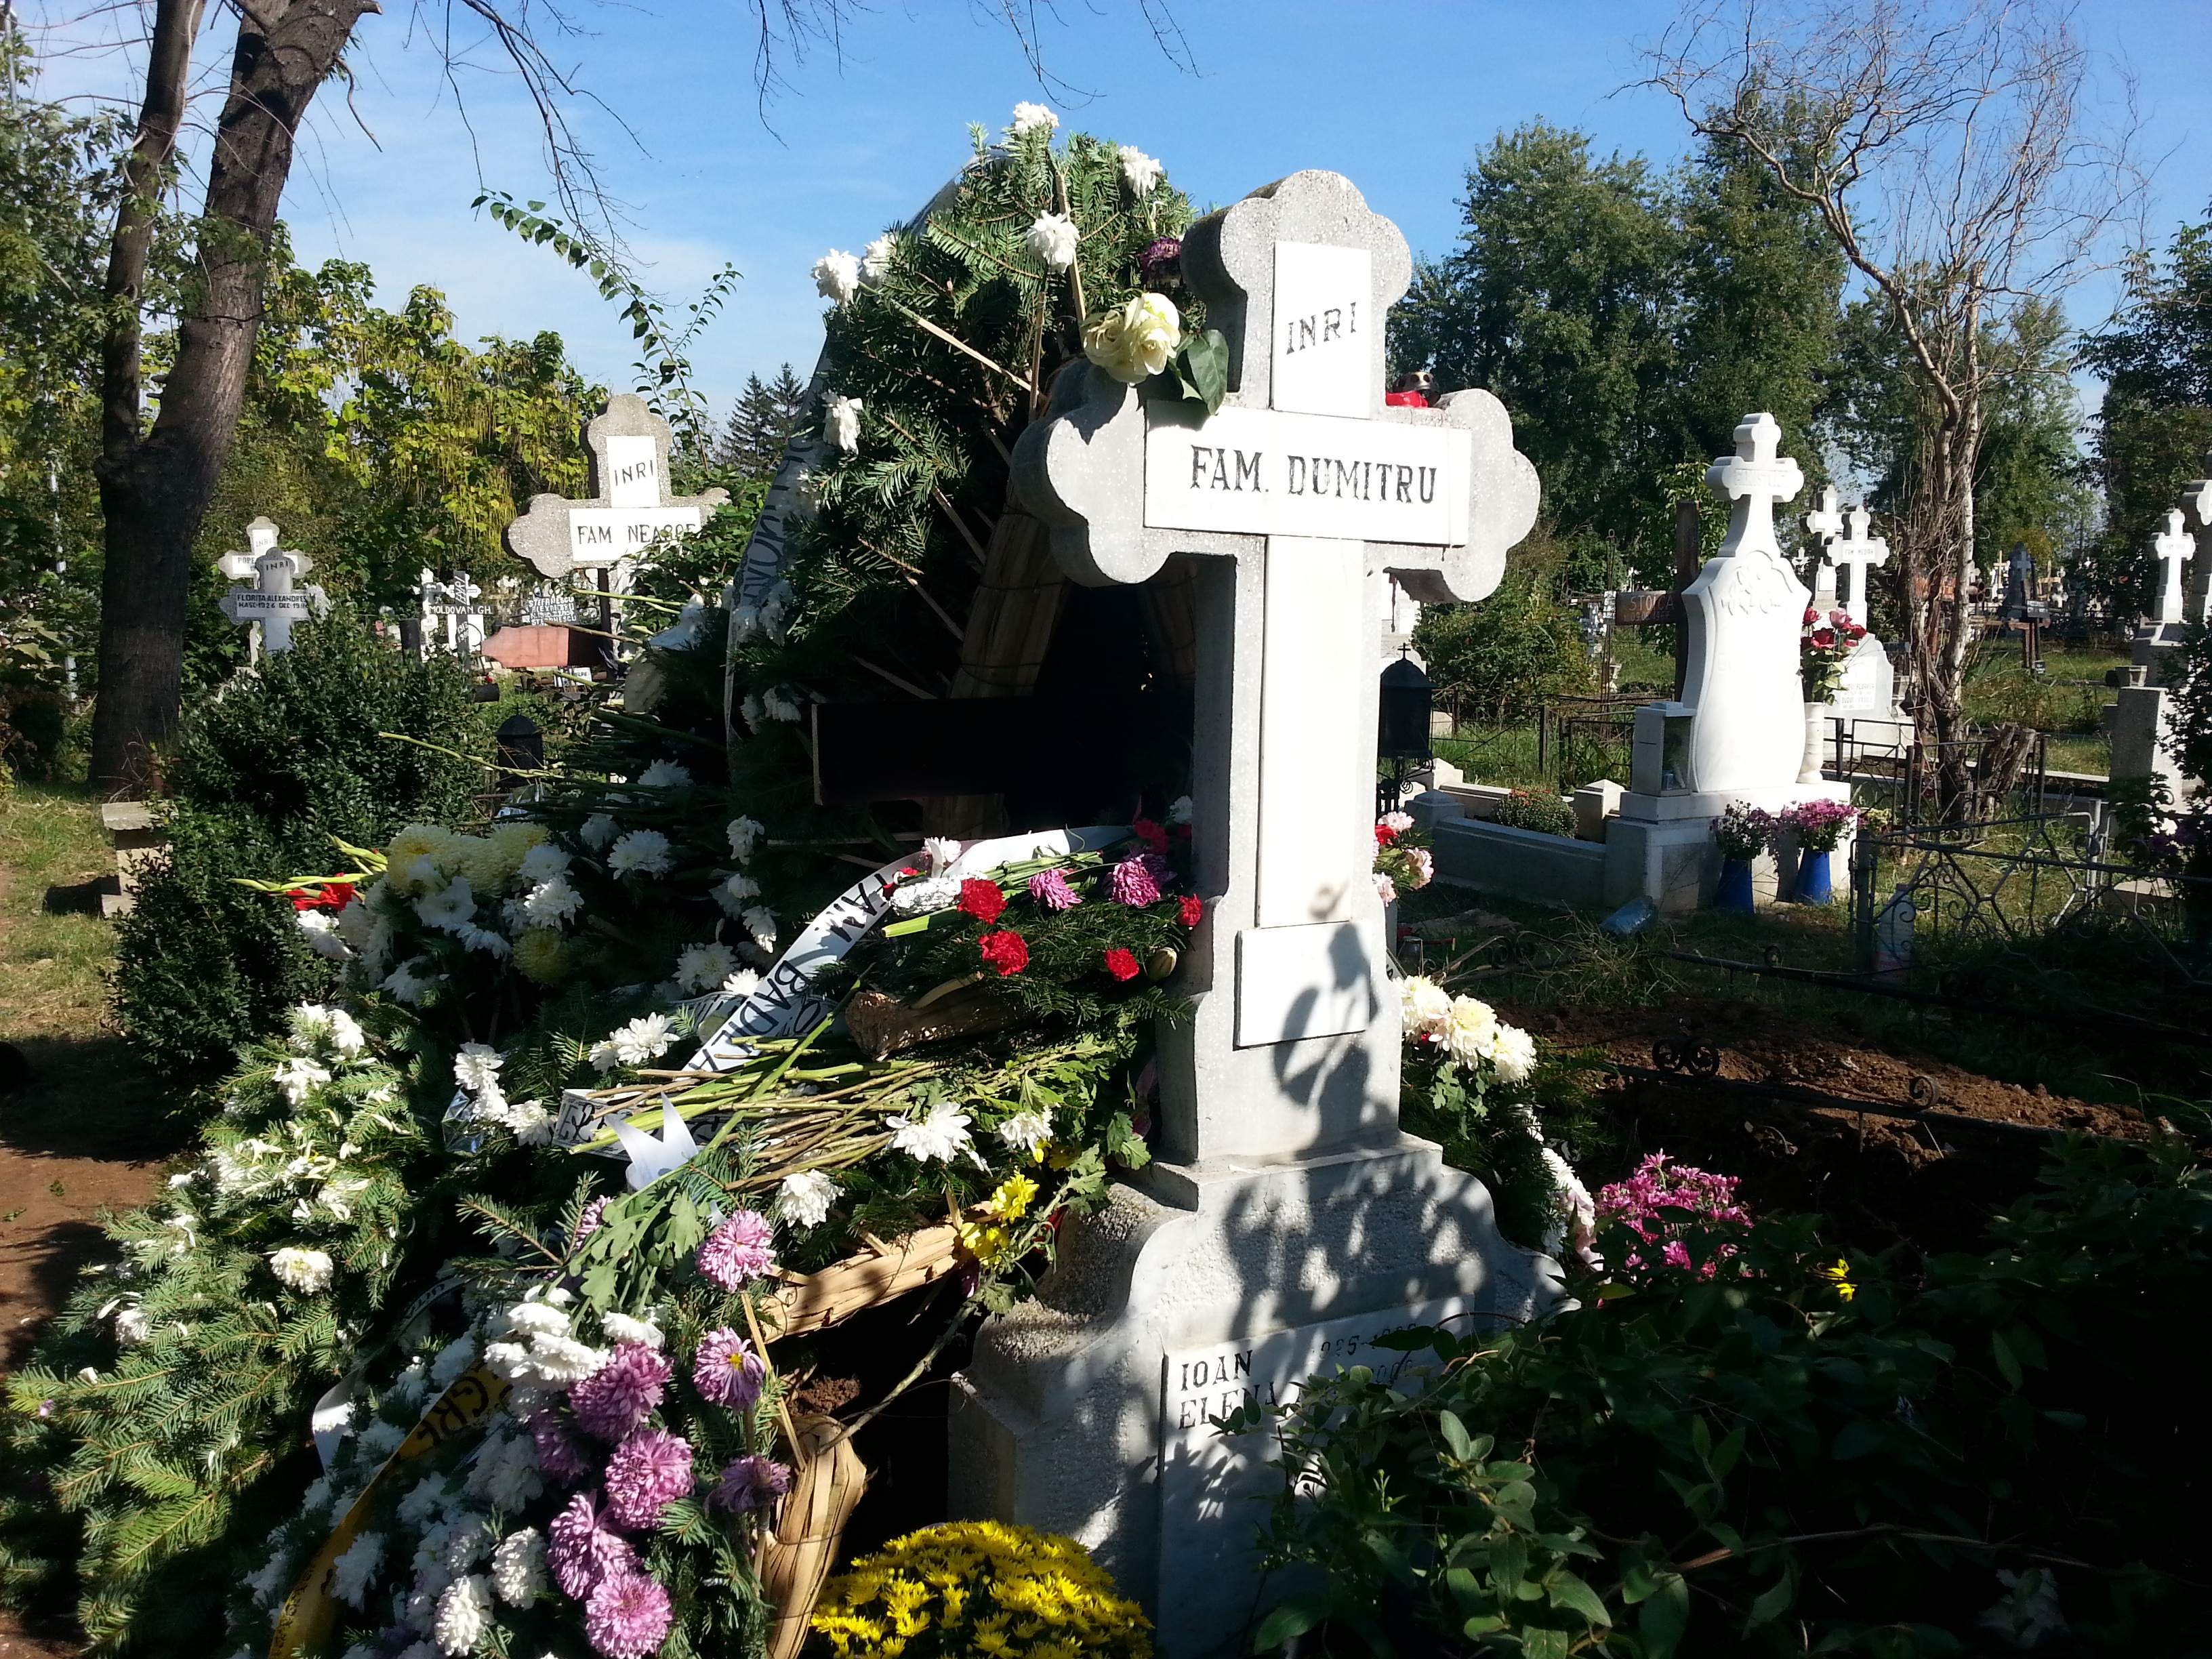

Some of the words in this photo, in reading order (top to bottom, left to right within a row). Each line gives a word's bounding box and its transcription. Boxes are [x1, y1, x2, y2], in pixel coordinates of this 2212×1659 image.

[1285, 301, 1357, 356] INRI
[614, 459, 654, 487] INRI
[1189, 444, 1270, 493] FAM.
[1287, 455, 1437, 504] DUMITRU
[577, 525, 613, 545] FAM
[266, 560, 289, 571] INRI
[1629, 594, 1675, 611] STOICA
[1181, 1349, 1253, 1392] IOAN
